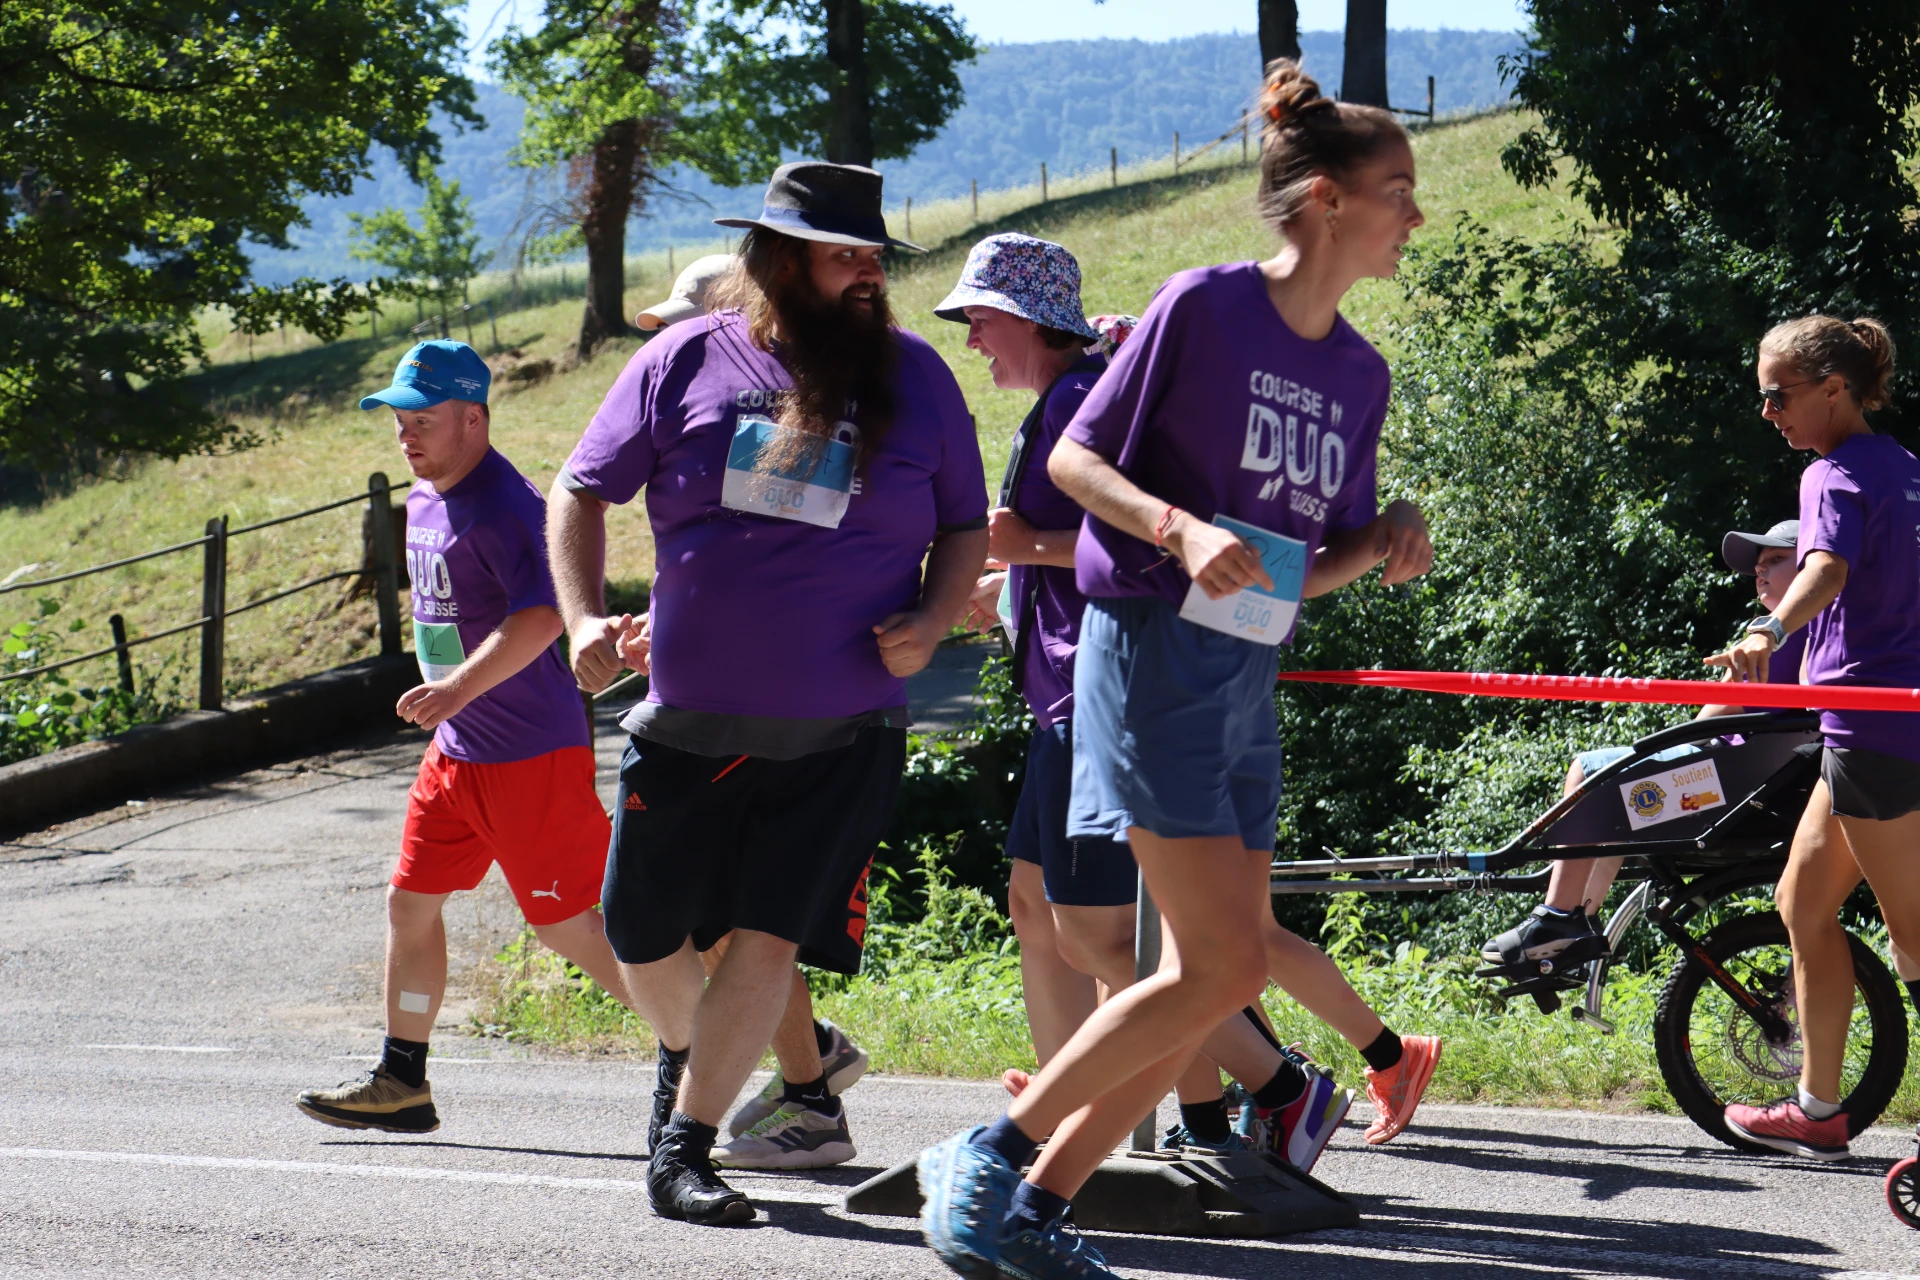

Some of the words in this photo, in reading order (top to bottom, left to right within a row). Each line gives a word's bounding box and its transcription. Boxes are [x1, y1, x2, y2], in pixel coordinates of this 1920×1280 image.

[1250, 370, 1323, 418] COURSE
[1240, 403, 1345, 499] DUO
[764, 487, 805, 509] DUO
[1289, 489, 1330, 524] SUISS
[423, 600, 459, 617] SUISSE
[1232, 601, 1272, 628] DUO
[1634, 782, 1657, 794] LIONS
[1671, 764, 1714, 788] Soutient
